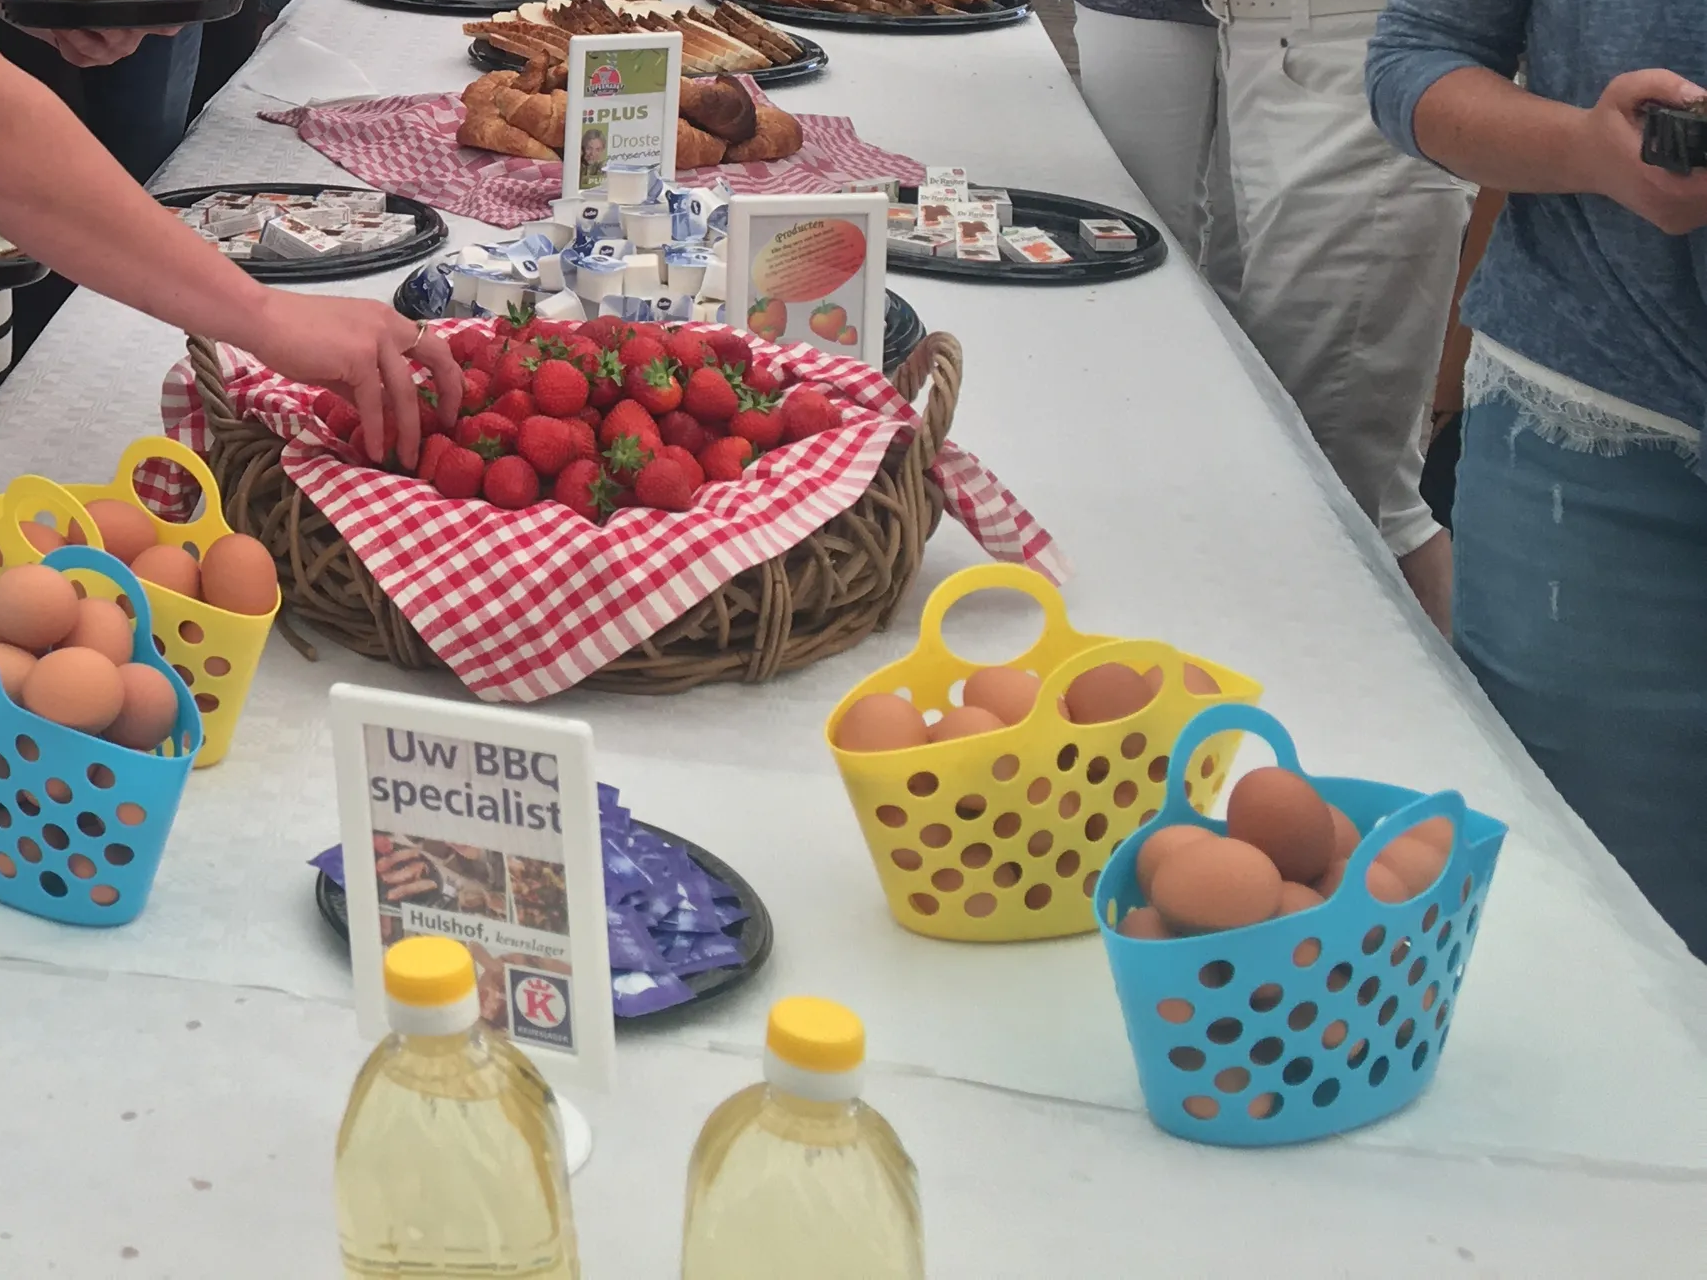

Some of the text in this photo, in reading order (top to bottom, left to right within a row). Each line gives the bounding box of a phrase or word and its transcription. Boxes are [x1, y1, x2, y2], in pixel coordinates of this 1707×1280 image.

[597, 105, 649, 123] PLUS
[612, 133, 660, 148] Droste
[588, 177, 606, 185] PLU
[774, 220, 825, 243] Producten
[386, 727, 560, 793] Uw BBQ
[371, 775, 562, 834] specialist
[410, 910, 565, 956] Hulshof, keurslager
[522, 988, 559, 1024] K
